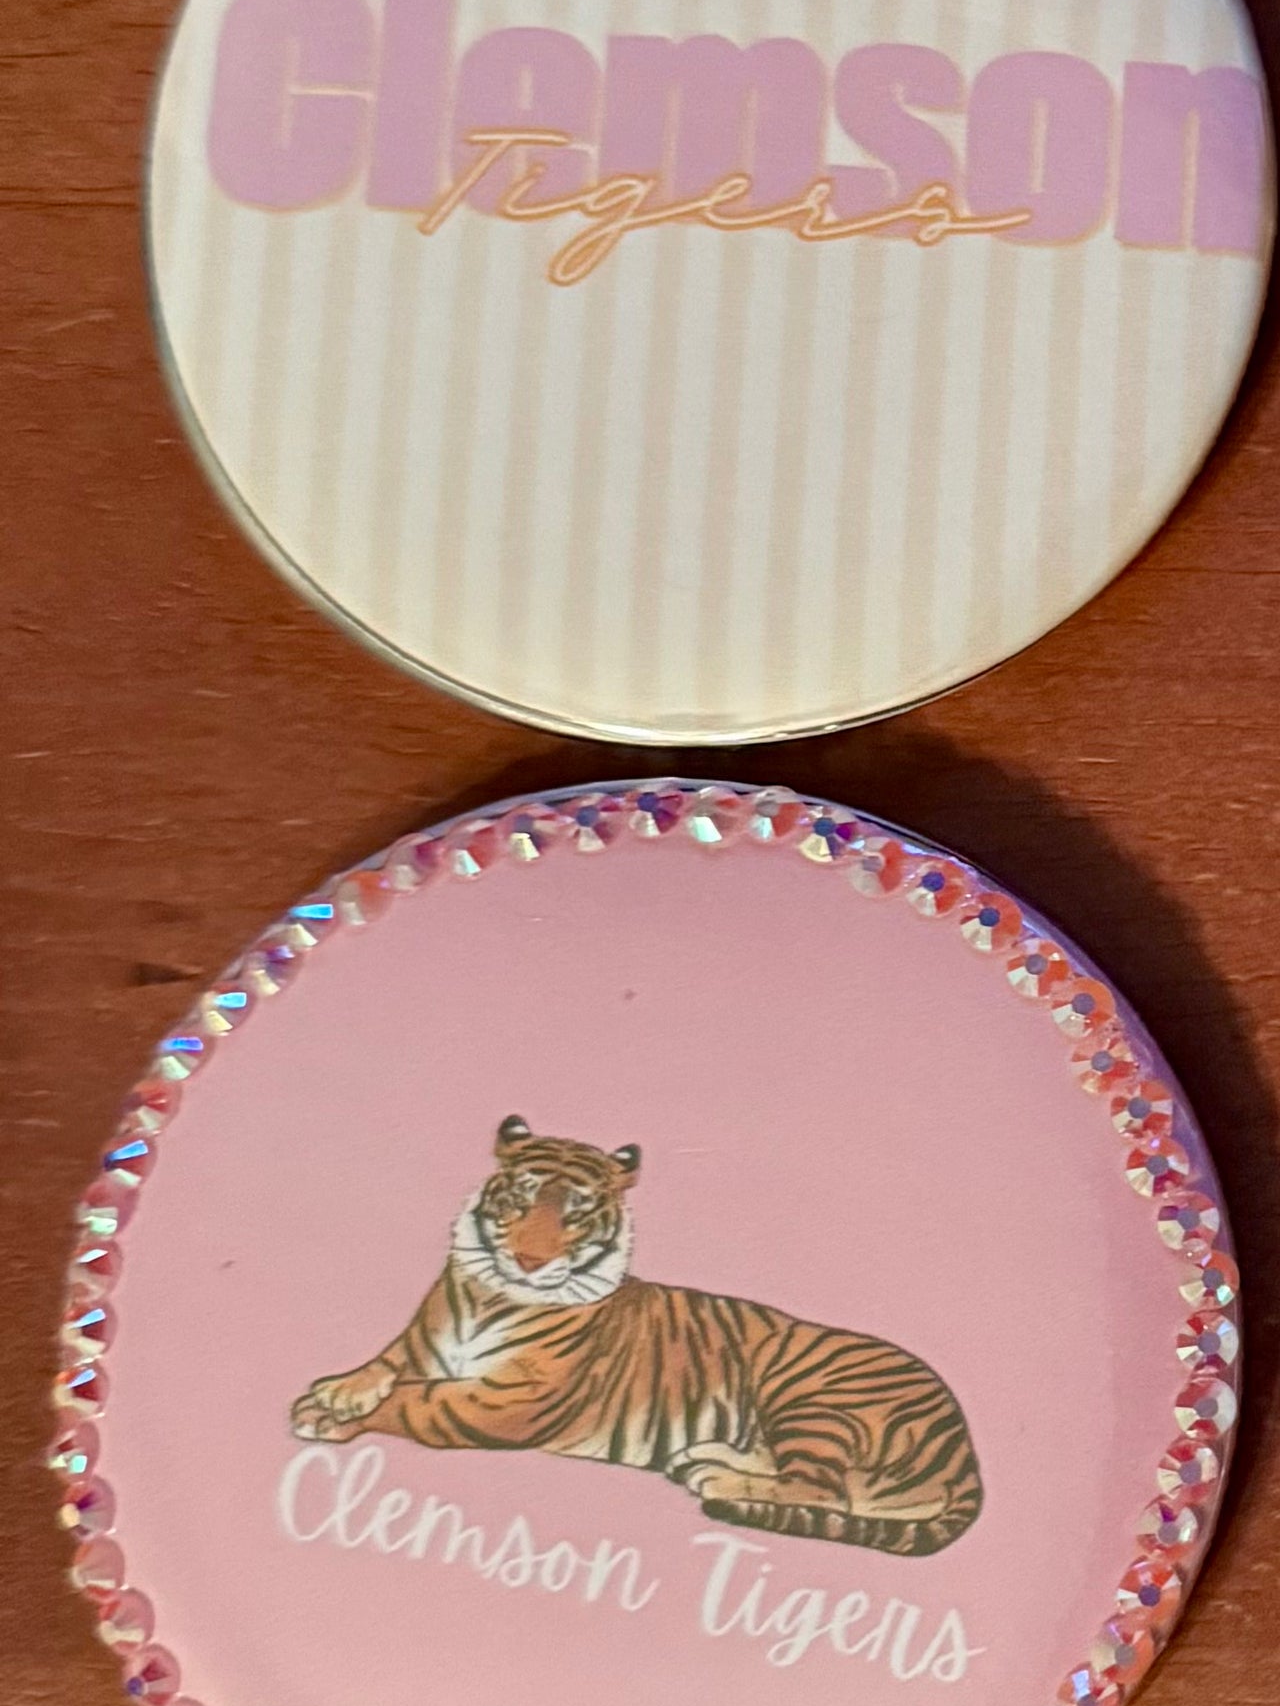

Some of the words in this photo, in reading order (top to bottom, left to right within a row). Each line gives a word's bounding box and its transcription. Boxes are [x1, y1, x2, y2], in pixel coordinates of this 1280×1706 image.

[417, 128, 1031, 284] Tigers
[280, 1445, 660, 1610] Clemson
[694, 1534, 986, 1681] Tigers
